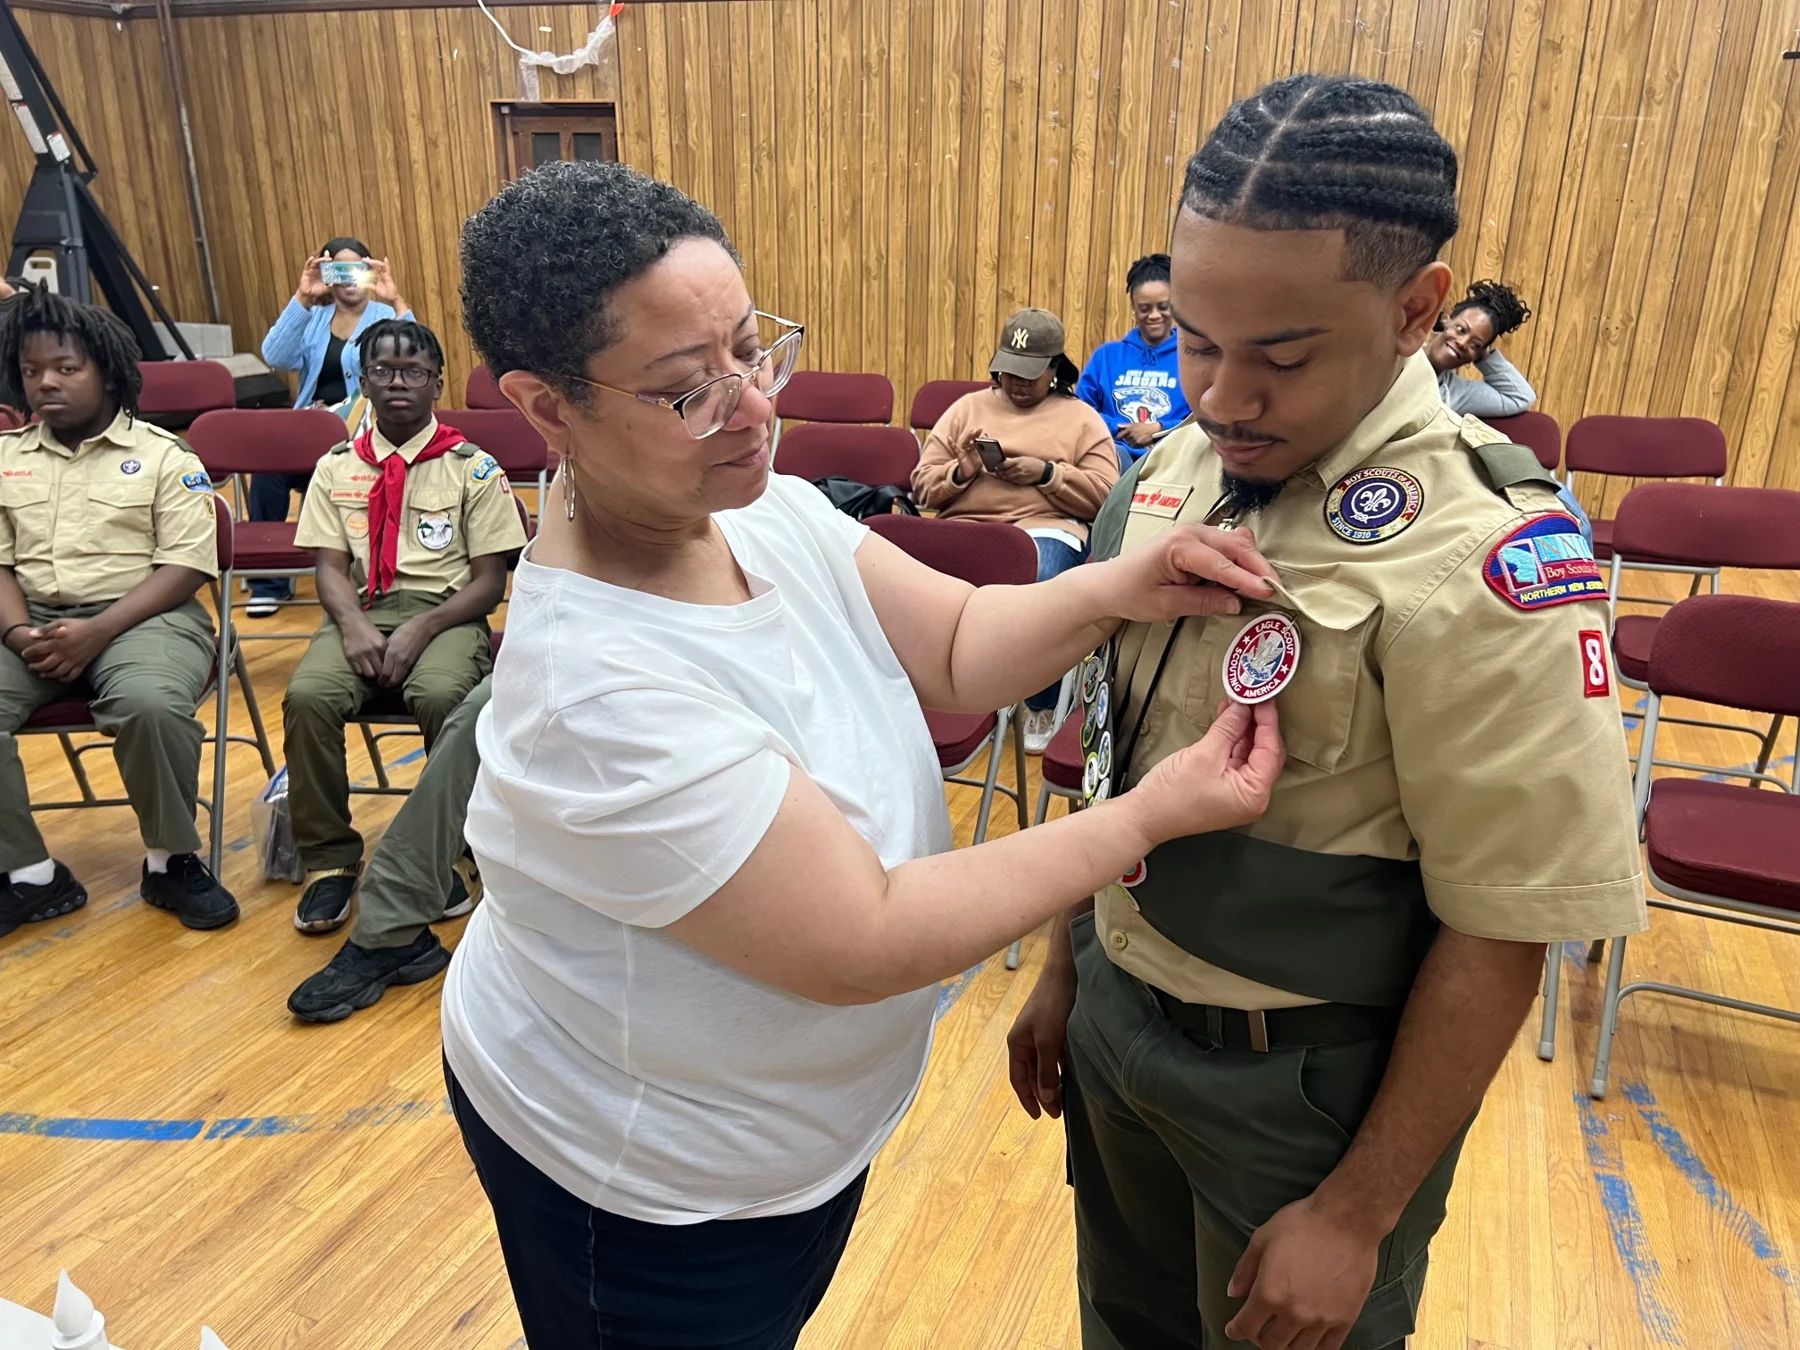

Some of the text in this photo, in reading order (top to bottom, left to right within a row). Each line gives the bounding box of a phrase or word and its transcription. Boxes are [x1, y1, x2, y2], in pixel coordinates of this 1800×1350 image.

[1011, 328, 1029, 348] NY
[1115, 375, 1177, 388] JAGUARS
[1344, 472, 1361, 485] BOY
[1363, 469, 1399, 478] SCOUTS
[1403, 480, 1419, 515] AMERICA
[1332, 517, 1371, 539] SINCE 1910
[1545, 566, 1565, 578] Boy
[1566, 564, 1591, 575] Scouts
[1520, 585, 1567, 603] NORTHERN
[1568, 582, 1585, 592] NEW
[1255, 621, 1294, 656] EAGLE SCOUT
[1229, 647, 1281, 697] SCOUTING AMERICA
[1585, 638, 1605, 686] 8
